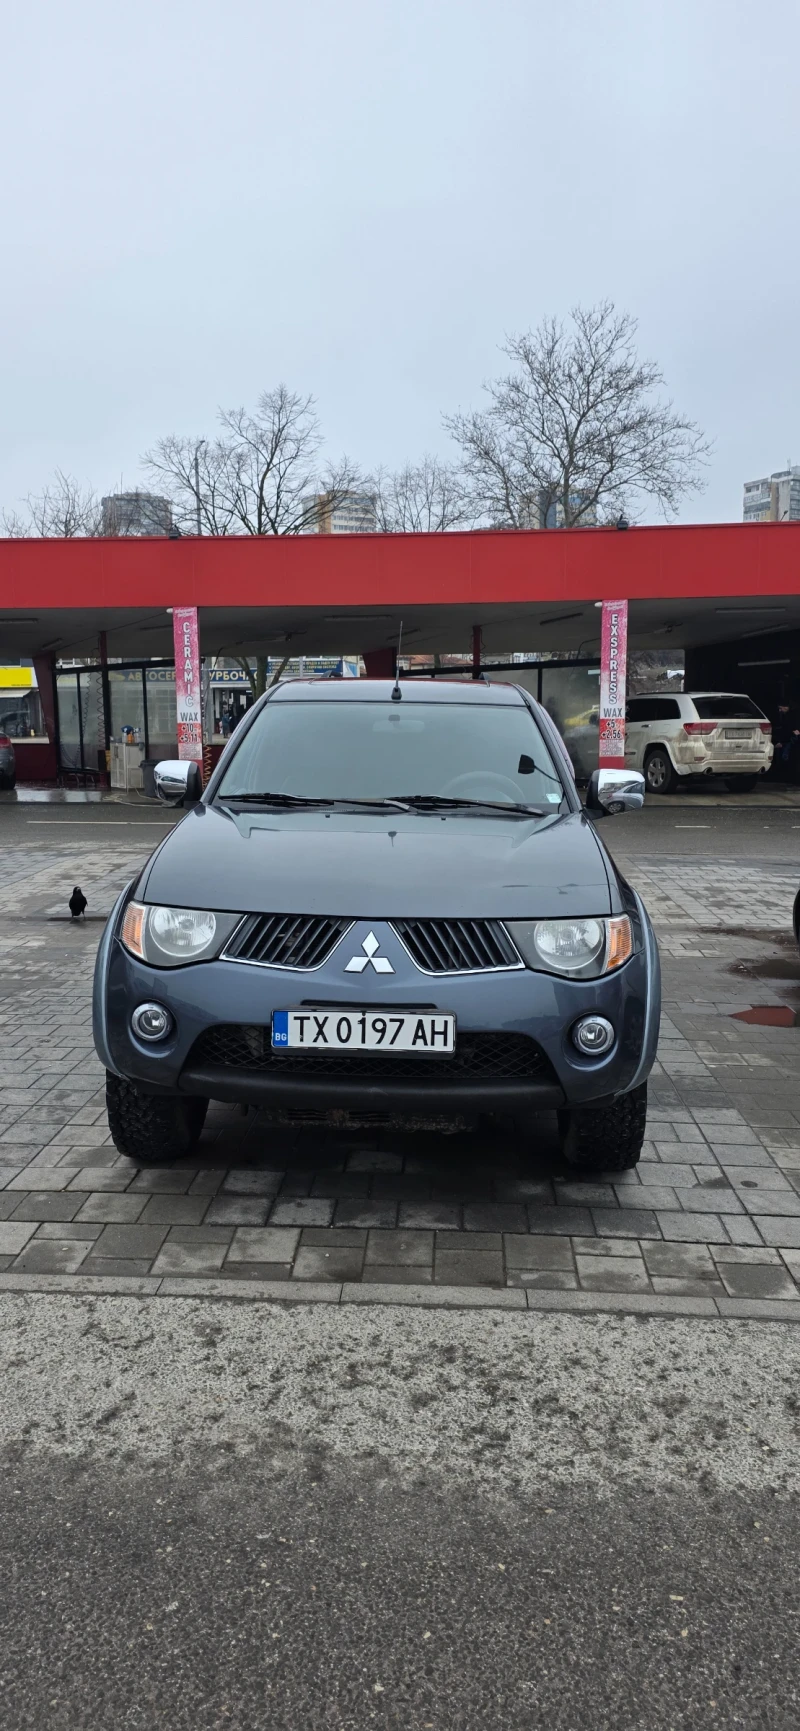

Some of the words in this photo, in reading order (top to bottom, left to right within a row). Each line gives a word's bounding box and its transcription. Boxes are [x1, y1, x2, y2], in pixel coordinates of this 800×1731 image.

[183, 621, 193, 707] CERAMIC
[609, 613, 619, 704] EXSPRESS
[180, 712, 198, 721] WAX
[603, 707, 622, 717] WAX
[275, 1032, 287, 1041] BG
[293, 1016, 329, 1043] TX
[336, 1017, 405, 1045] 0197
[411, 1019, 448, 1046] AH
